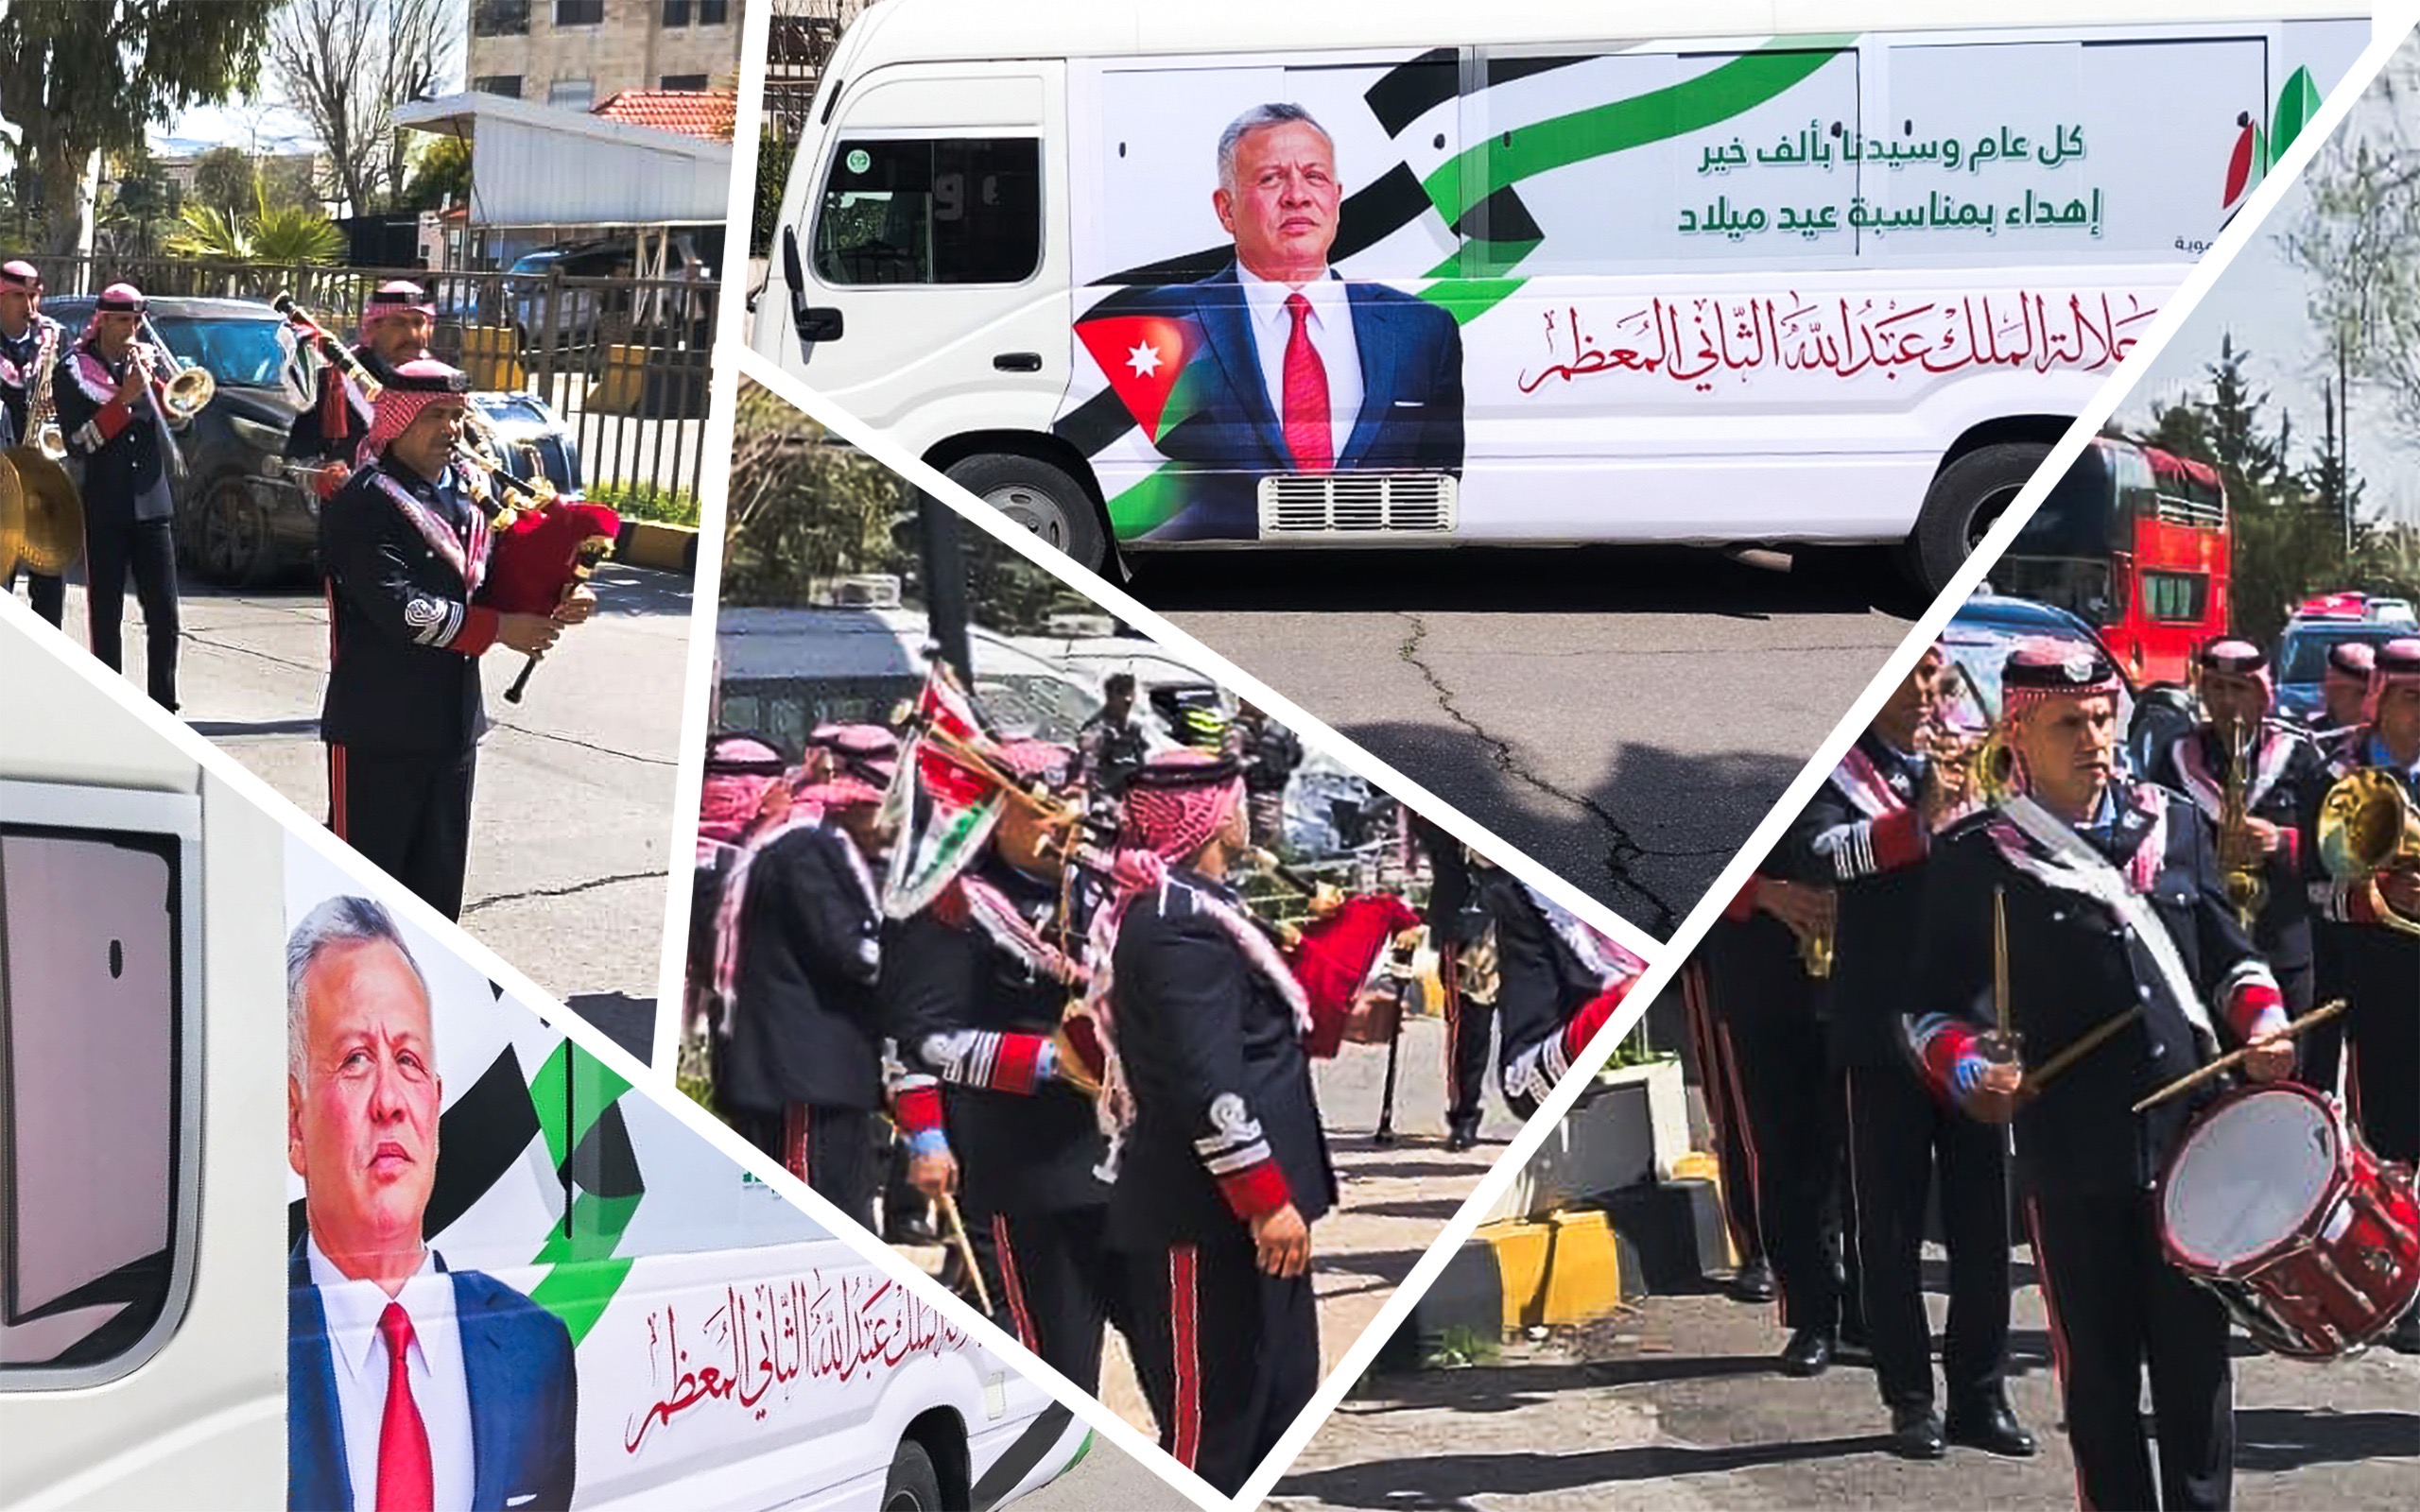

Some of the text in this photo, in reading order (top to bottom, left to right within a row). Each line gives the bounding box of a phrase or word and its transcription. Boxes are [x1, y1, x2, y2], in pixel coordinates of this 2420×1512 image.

[1697, 118, 2084, 174] كل عام وسيدنا بألف خير
[1677, 187, 2100, 238] إهداء بمناسبة عيد ميلاد
